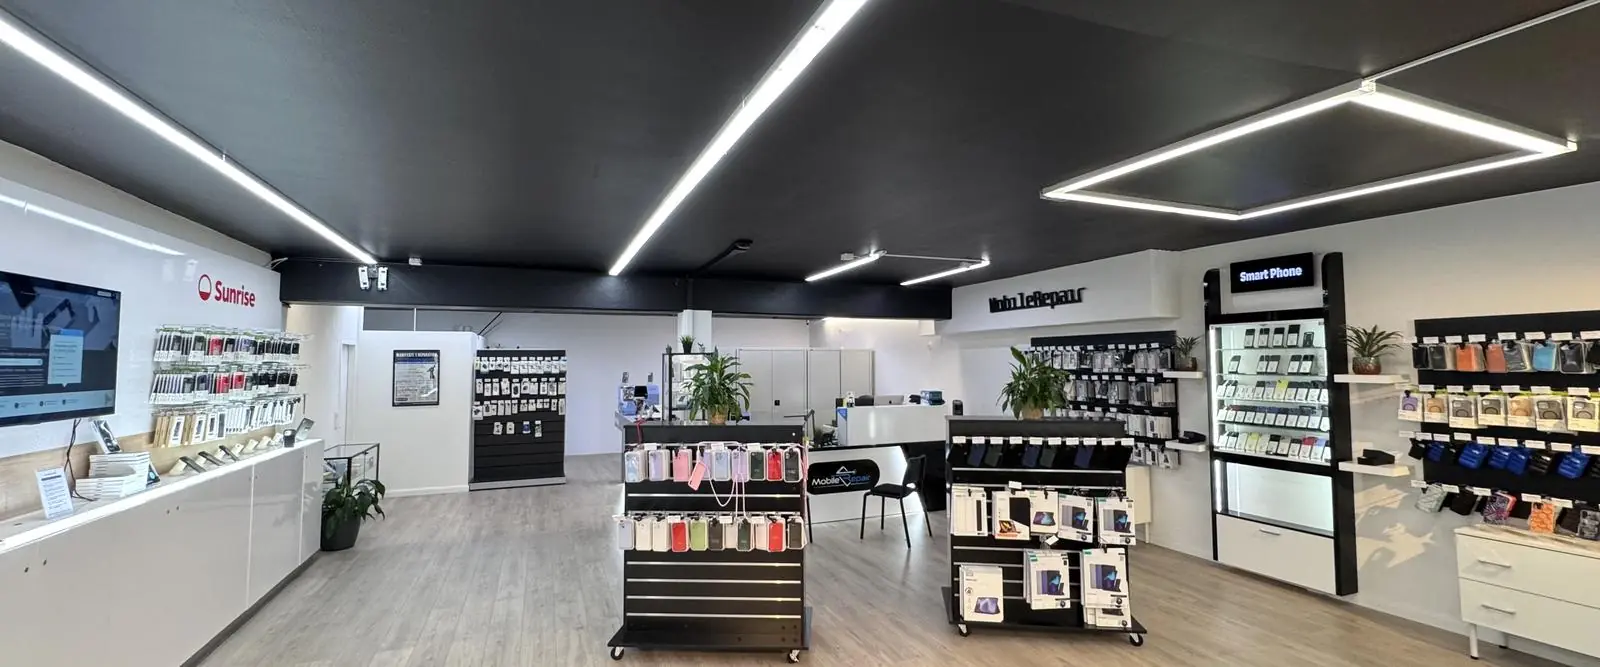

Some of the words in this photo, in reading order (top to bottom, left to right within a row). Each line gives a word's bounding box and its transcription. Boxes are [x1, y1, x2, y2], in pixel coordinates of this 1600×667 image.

[1239, 269, 1269, 282] Smart
[1270, 266, 1303, 279] Phone
[214, 280, 256, 308] Sunrise
